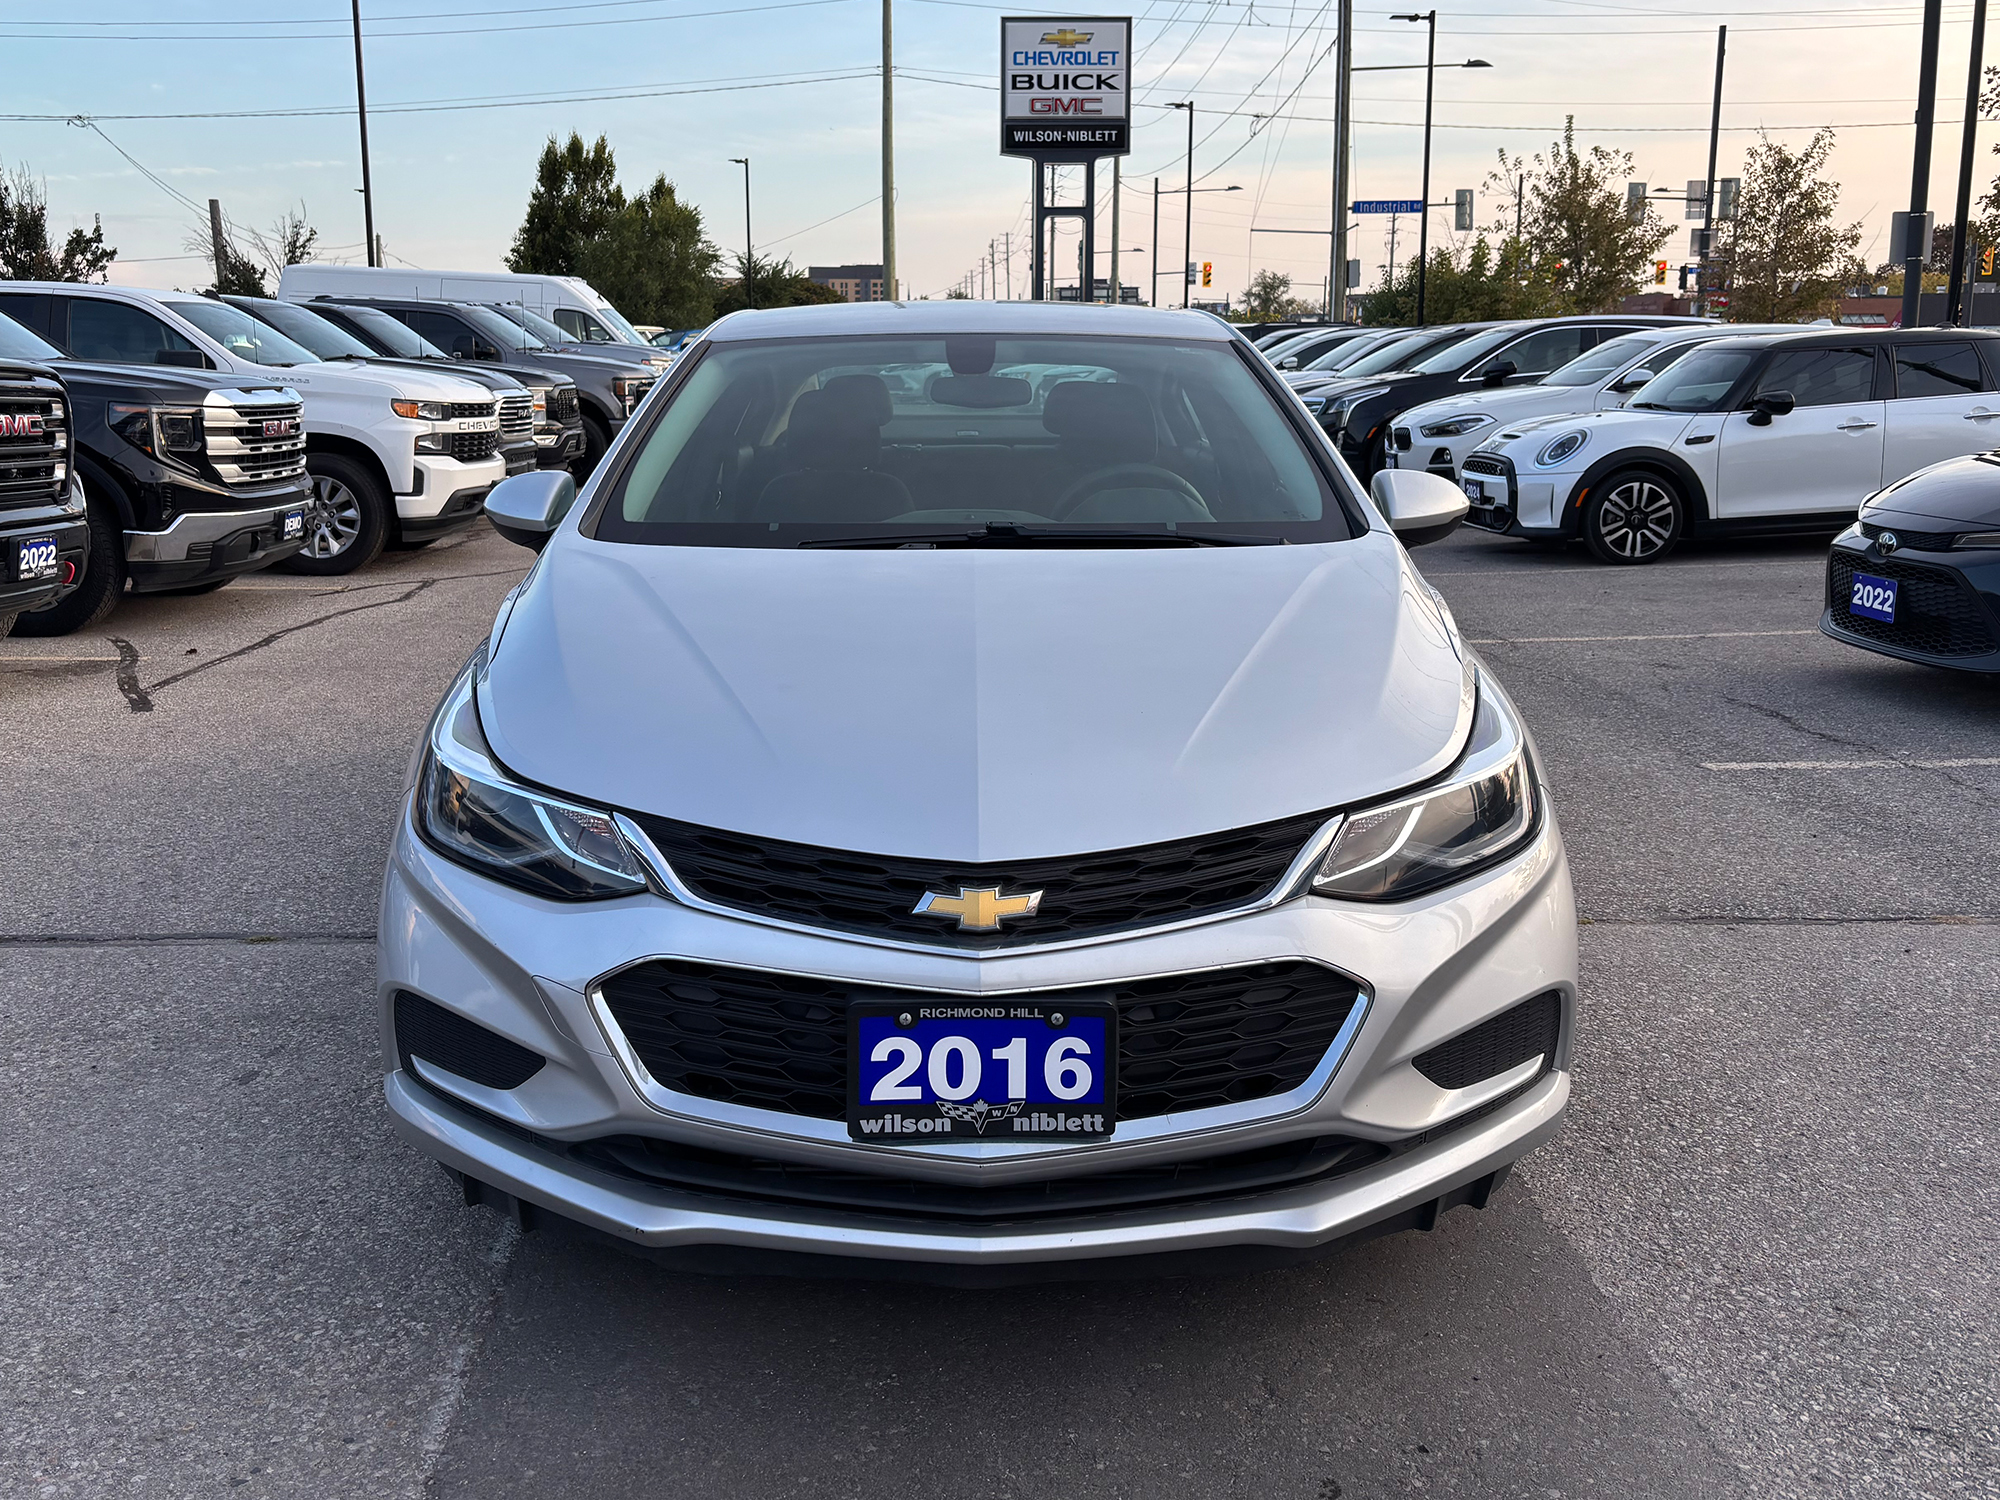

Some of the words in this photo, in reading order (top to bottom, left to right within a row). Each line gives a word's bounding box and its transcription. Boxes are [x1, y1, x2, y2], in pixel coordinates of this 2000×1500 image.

[1013, 51, 1119, 66] CHEVROLET
[1011, 74, 1120, 90] BUICK
[1030, 97, 1103, 114] GMC
[1013, 130, 1118, 142] WILSON-NIBLETT
[1359, 202, 1411, 213] Industrial
[0, 414, 43, 436] MC
[262, 419, 297, 438] GMC
[1465, 484, 1480, 500] 2024
[285, 515, 302, 532] DEMO
[20, 544, 57, 571] 2022
[1852, 582, 1894, 613] 2022
[920, 1008, 1006, 1018] RICHMOND
[1010, 1008, 1044, 1018] HILL
[870, 1035, 1093, 1101] 2016
[992, 1109, 1002, 1117] W
[1010, 1105, 1018, 1113] N
[859, 1114, 952, 1134] wilson
[1013, 1112, 1105, 1132] niblett
